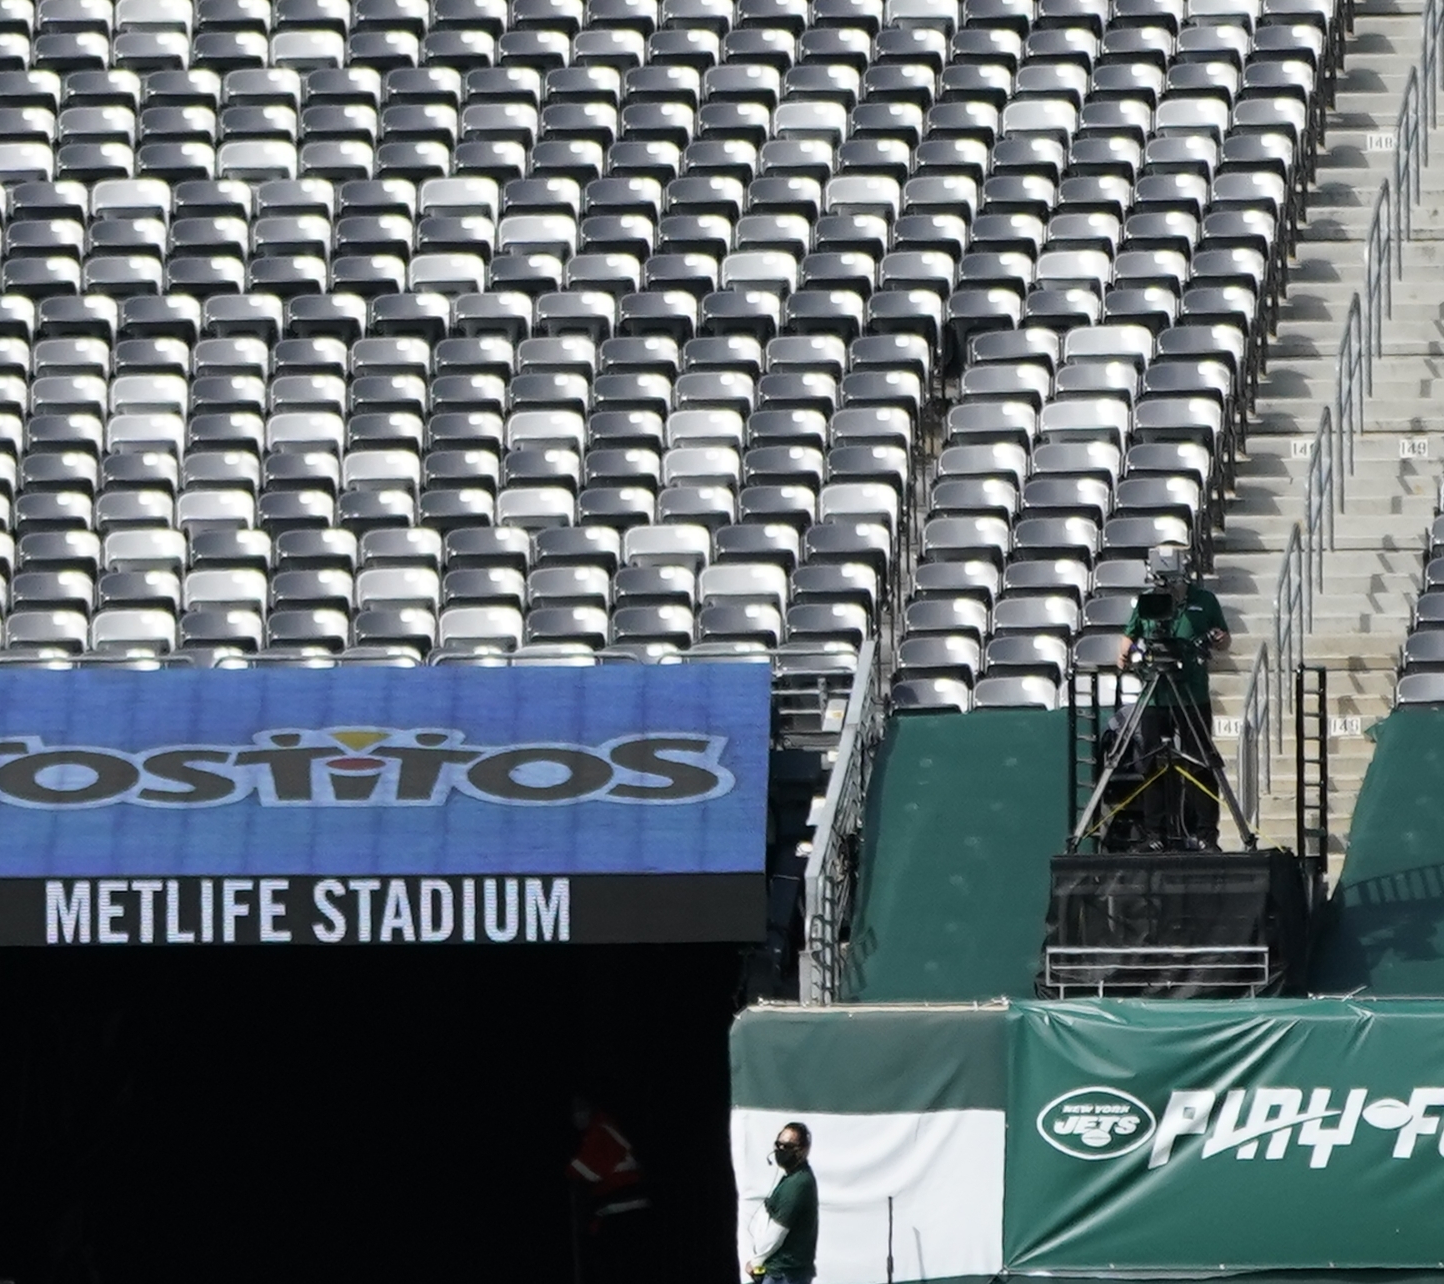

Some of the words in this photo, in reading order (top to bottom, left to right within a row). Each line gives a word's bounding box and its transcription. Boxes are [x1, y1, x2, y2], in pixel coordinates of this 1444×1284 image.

[44, 877, 292, 945] METLIFE
[312, 876, 571, 943] STADIUM
[1053, 1115, 1141, 1135] JETS
[1061, 1104, 1095, 1114] NEW
[1094, 1103, 1131, 1114] YORK
[1147, 1087, 1368, 1171] PLAY
